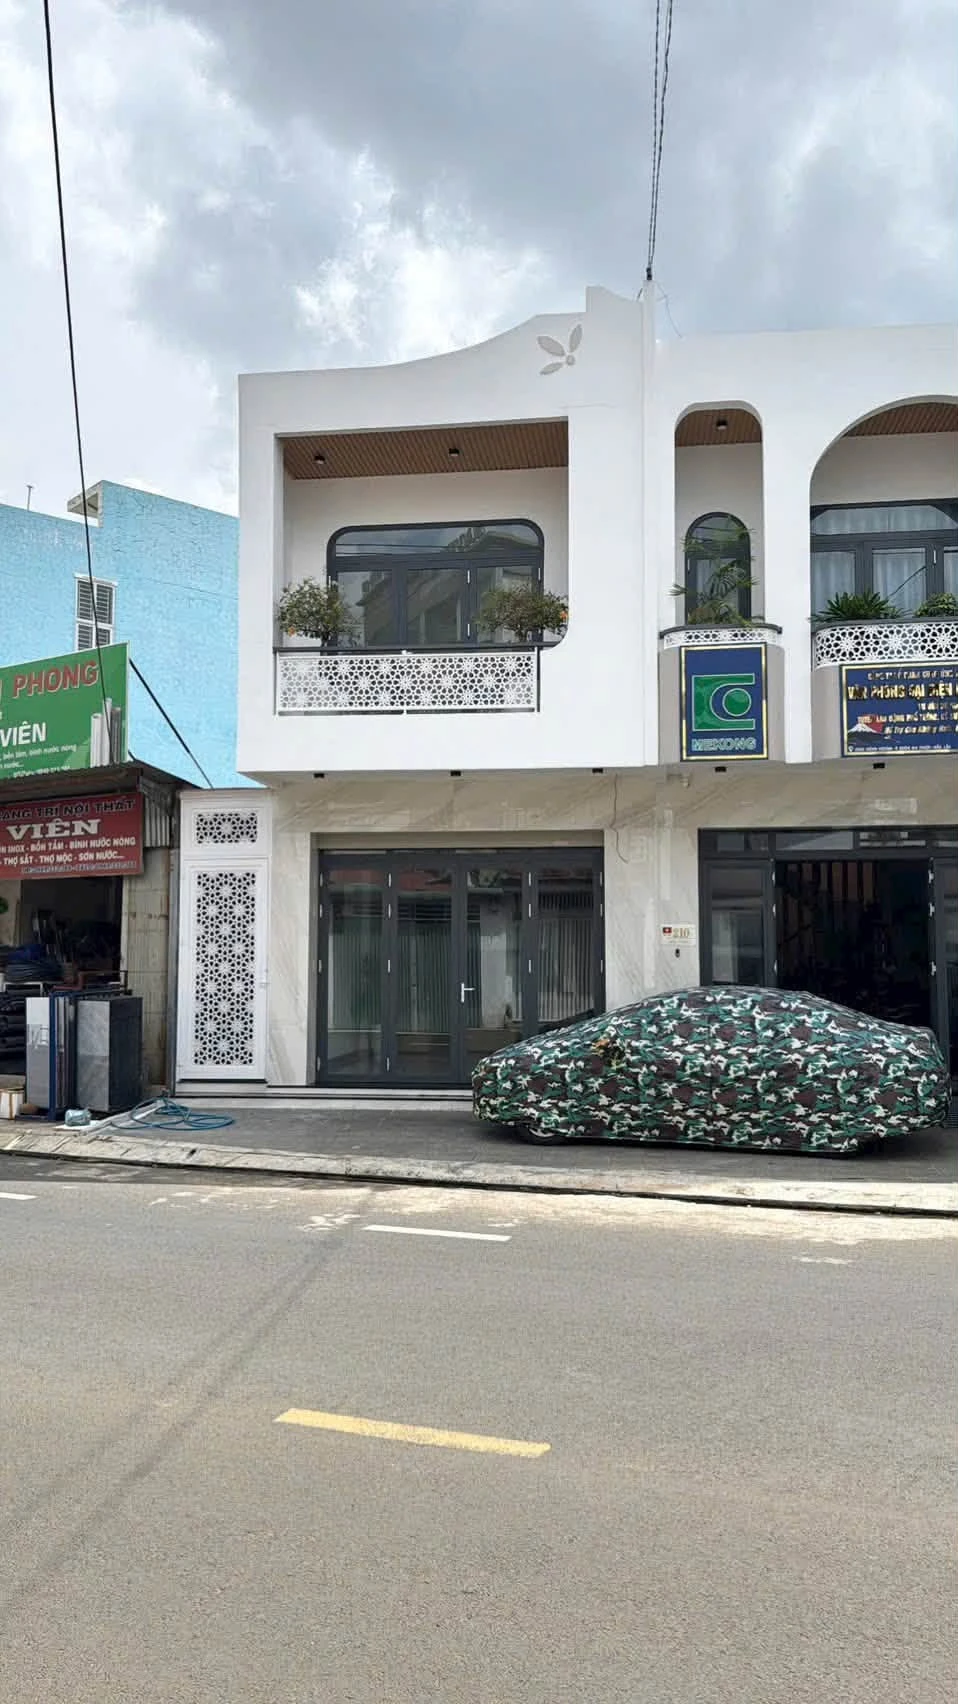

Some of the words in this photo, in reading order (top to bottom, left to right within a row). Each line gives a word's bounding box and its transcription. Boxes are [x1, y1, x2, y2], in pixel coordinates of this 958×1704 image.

[12, 660, 100, 699] PHONG
[0, 721, 47, 748] VIÊN
[691, 736, 757, 752] MEKONG
[37, 802, 61, 817] TRÍ
[64, 801, 90, 818] NỘI
[95, 796, 136, 814] THẤT
[6, 818, 101, 841] VIÊN
[69, 838, 88, 849] BÌNH
[90, 836, 112, 848] NƯỚC
[113, 835, 136, 847] NÓNG
[56, 852, 73, 865] MỘC
